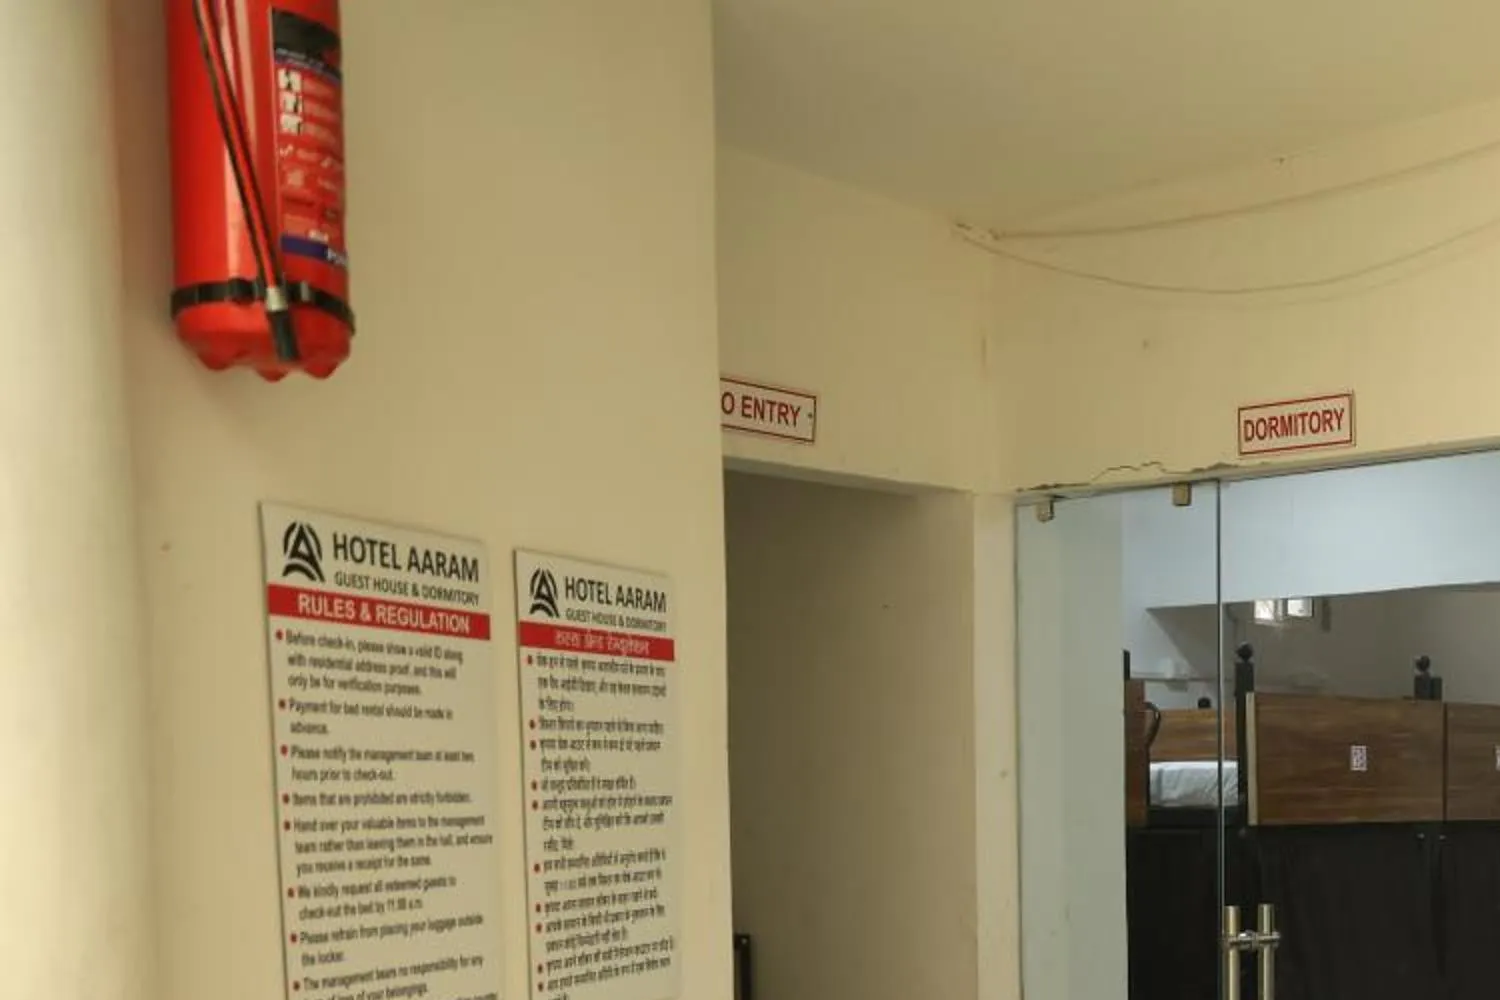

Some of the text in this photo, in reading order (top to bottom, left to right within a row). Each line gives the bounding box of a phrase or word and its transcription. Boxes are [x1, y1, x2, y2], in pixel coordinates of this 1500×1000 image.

[720, 391, 801, 427] O ENTRY
[1243, 408, 1345, 442] DORMITORY
[332, 532, 480, 583] HOTEL AARAM
[334, 570, 480, 607] GUEST HOUSE & DORMITORY
[564, 575, 667, 613] HOTEL AARAM
[297, 593, 470, 634] RULES & REGULATION
[288, 698, 327, 715] Payment
[291, 745, 320, 759] Please
